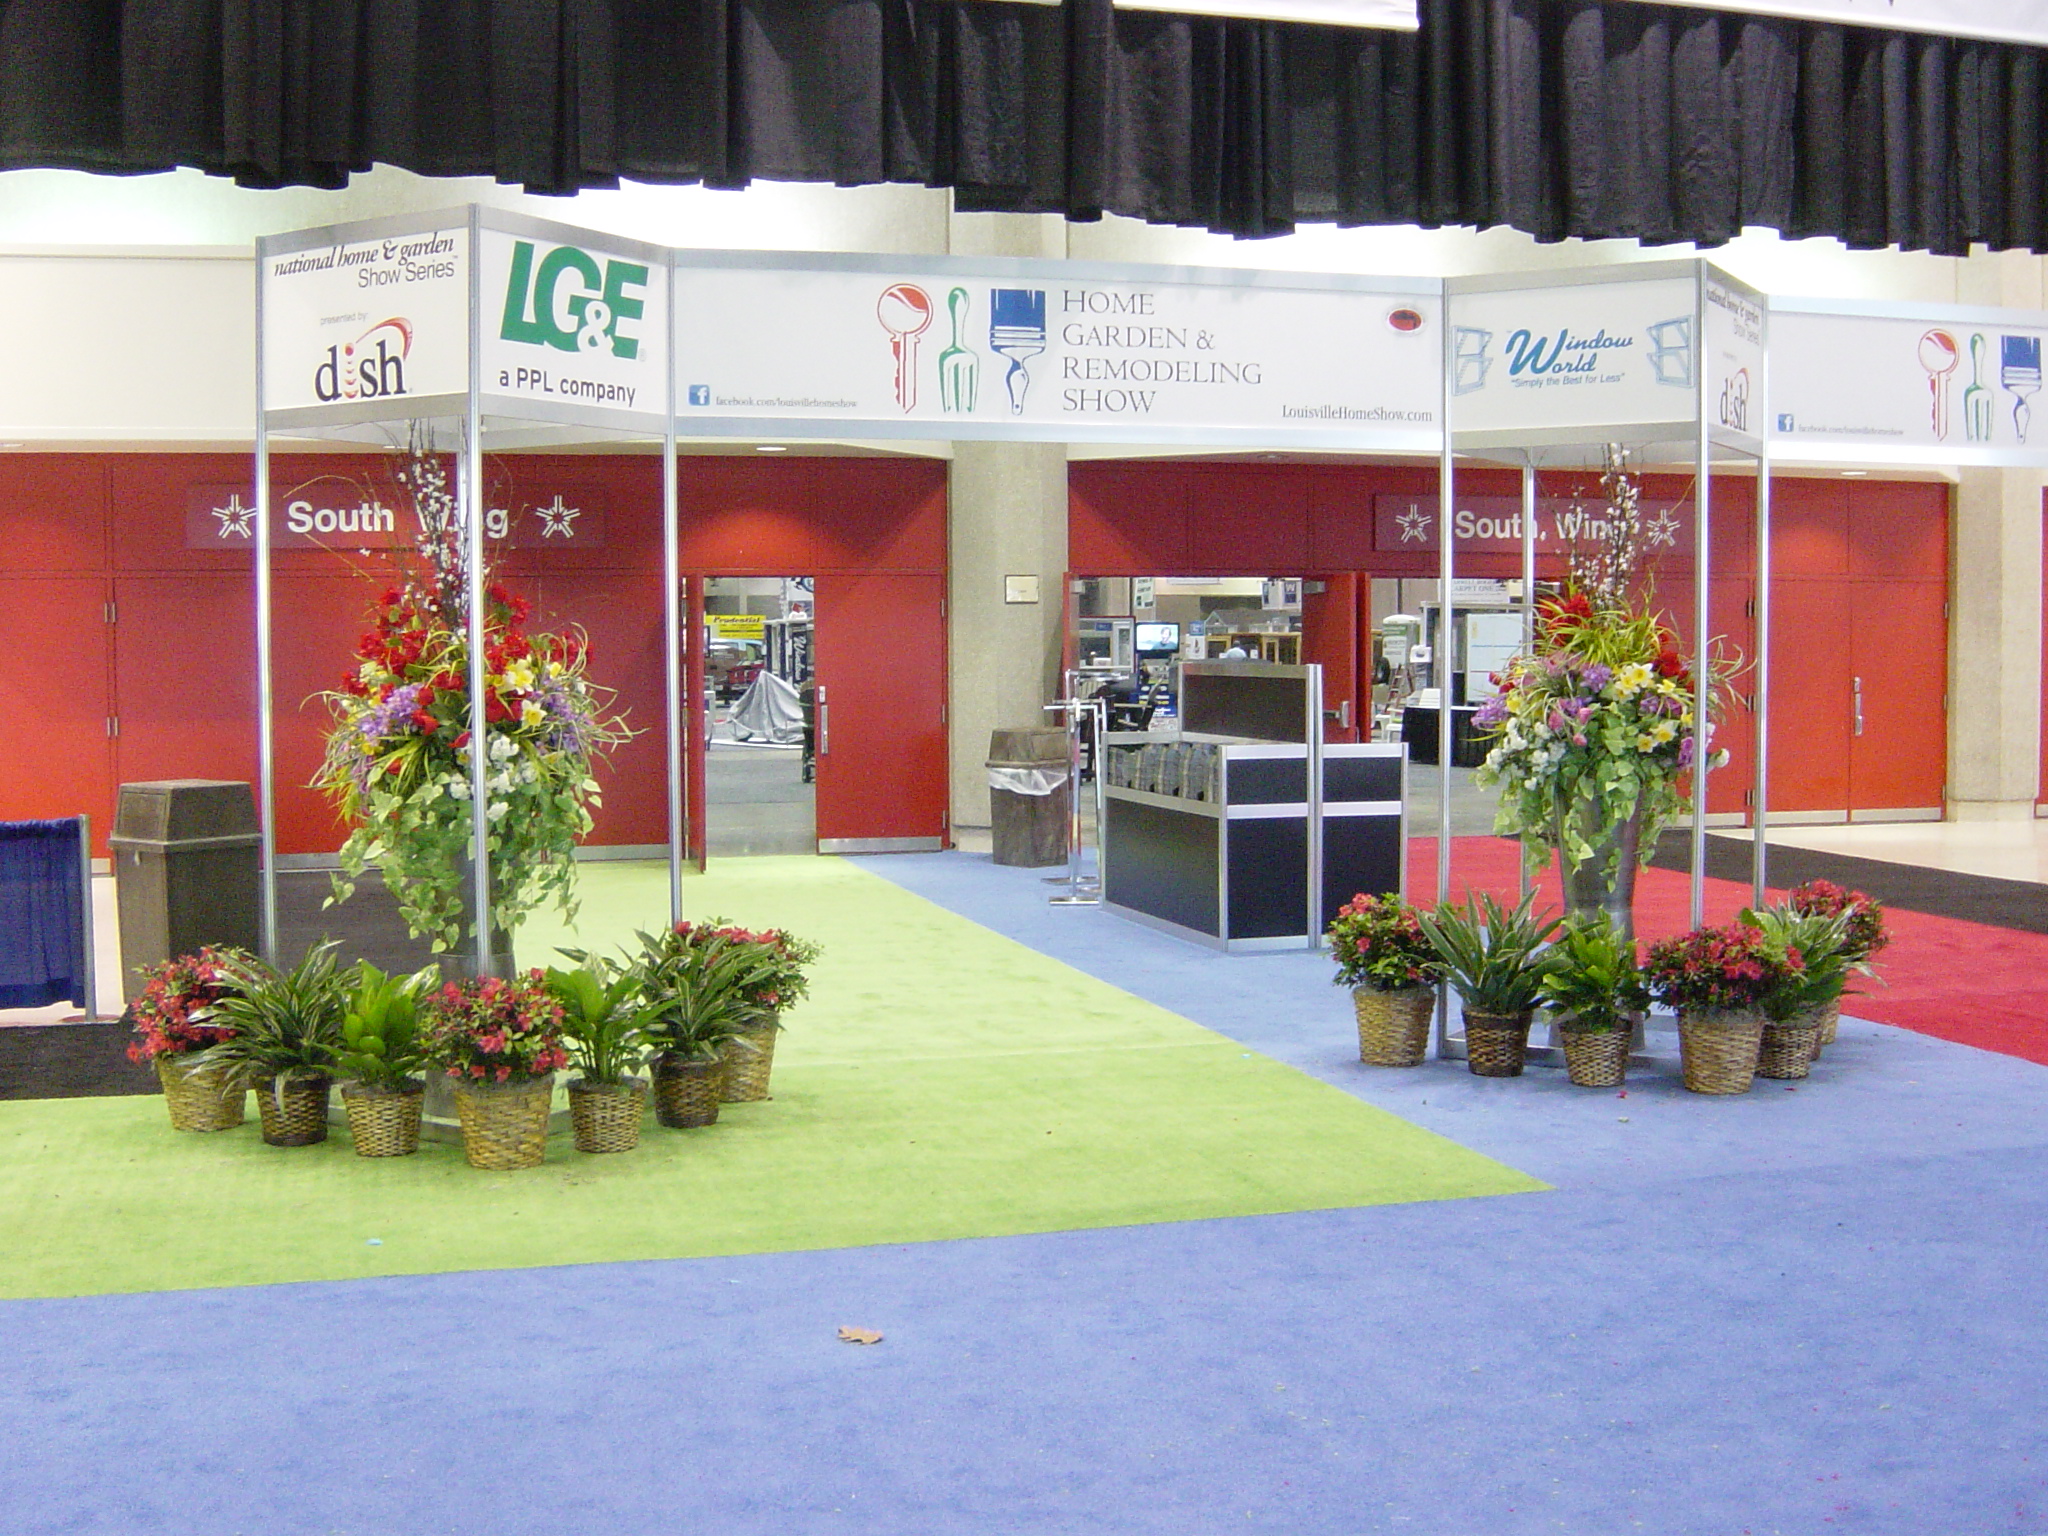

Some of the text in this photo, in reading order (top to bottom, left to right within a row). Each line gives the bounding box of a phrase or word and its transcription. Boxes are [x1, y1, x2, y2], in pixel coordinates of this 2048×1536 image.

[274, 232, 454, 276] national home & garden
[358, 259, 455, 288] Show Series
[500, 240, 649, 360] LG&E
[1063, 290, 1155, 315] HOME
[1063, 323, 1215, 350] GARDEN &
[315, 339, 407, 402] dish
[1063, 356, 1262, 385] REMODELING
[1546, 376, 1559, 386] the
[1563, 374, 1582, 385] Best
[1585, 373, 1598, 384] for
[499, 367, 636, 408] a PPL company
[1063, 388, 1156, 413] SHOW
[716, 396, 857, 408] facebook.com/louisvillehomeshow
[1282, 404, 1432, 422] LouisvilleHomeShow.com
[287, 501, 394, 533] South
[1455, 511, 1538, 539] Sout
